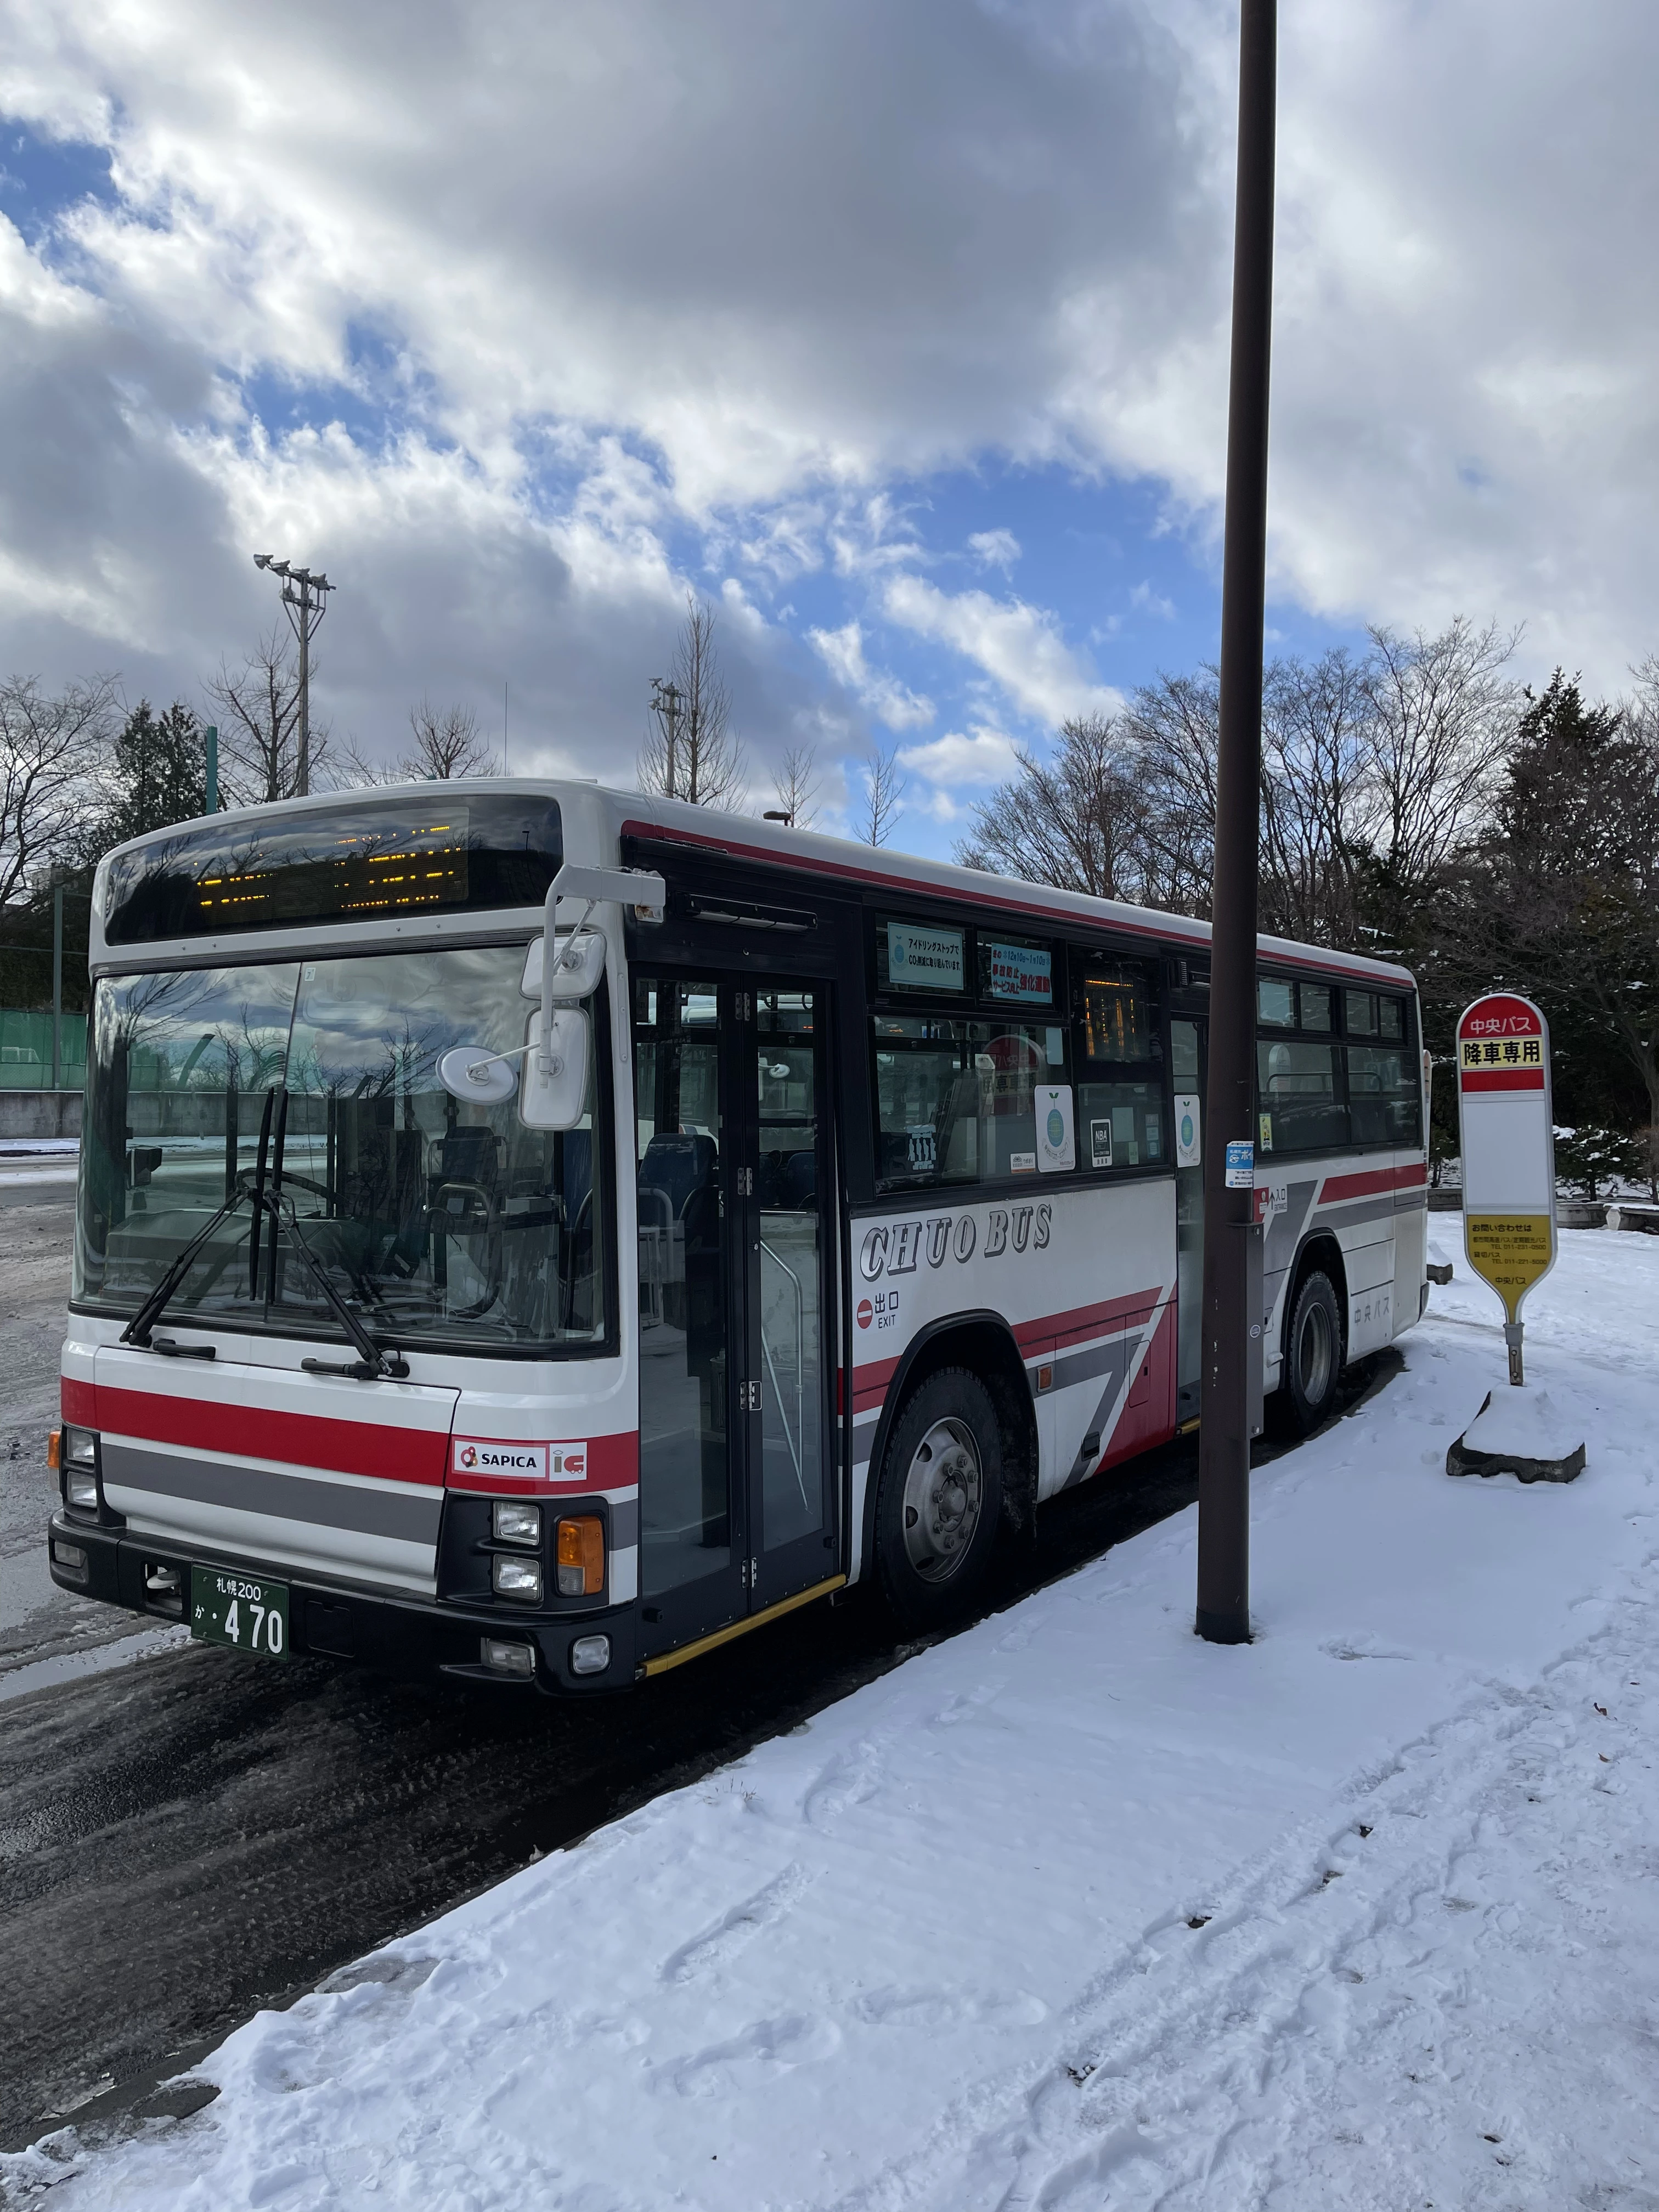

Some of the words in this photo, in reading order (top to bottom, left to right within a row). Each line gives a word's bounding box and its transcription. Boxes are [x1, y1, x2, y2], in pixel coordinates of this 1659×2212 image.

[908, 938, 960, 955] アイドリングストップで
[1470, 1015, 1532, 1035] 中央バス
[1464, 1040, 1541, 1066] 降車専用
[1095, 1130, 1108, 1141] NBA
[1276, 1188, 1285, 1201] 入口
[1472, 1223, 1532, 1233] お問い合わせは
[860, 1215, 977, 1282] CHUO
[984, 1204, 1052, 1259] BUS
[1495, 1276, 1527, 1285] 中央バス
[874, 1290, 899, 1314] 出口
[1354, 1296, 1390, 1327] 中央バス
[878, 1314, 896, 1329] EXIT
[481, 1453, 537, 1469] SAPICA
[194, 1604, 205, 1620] か
